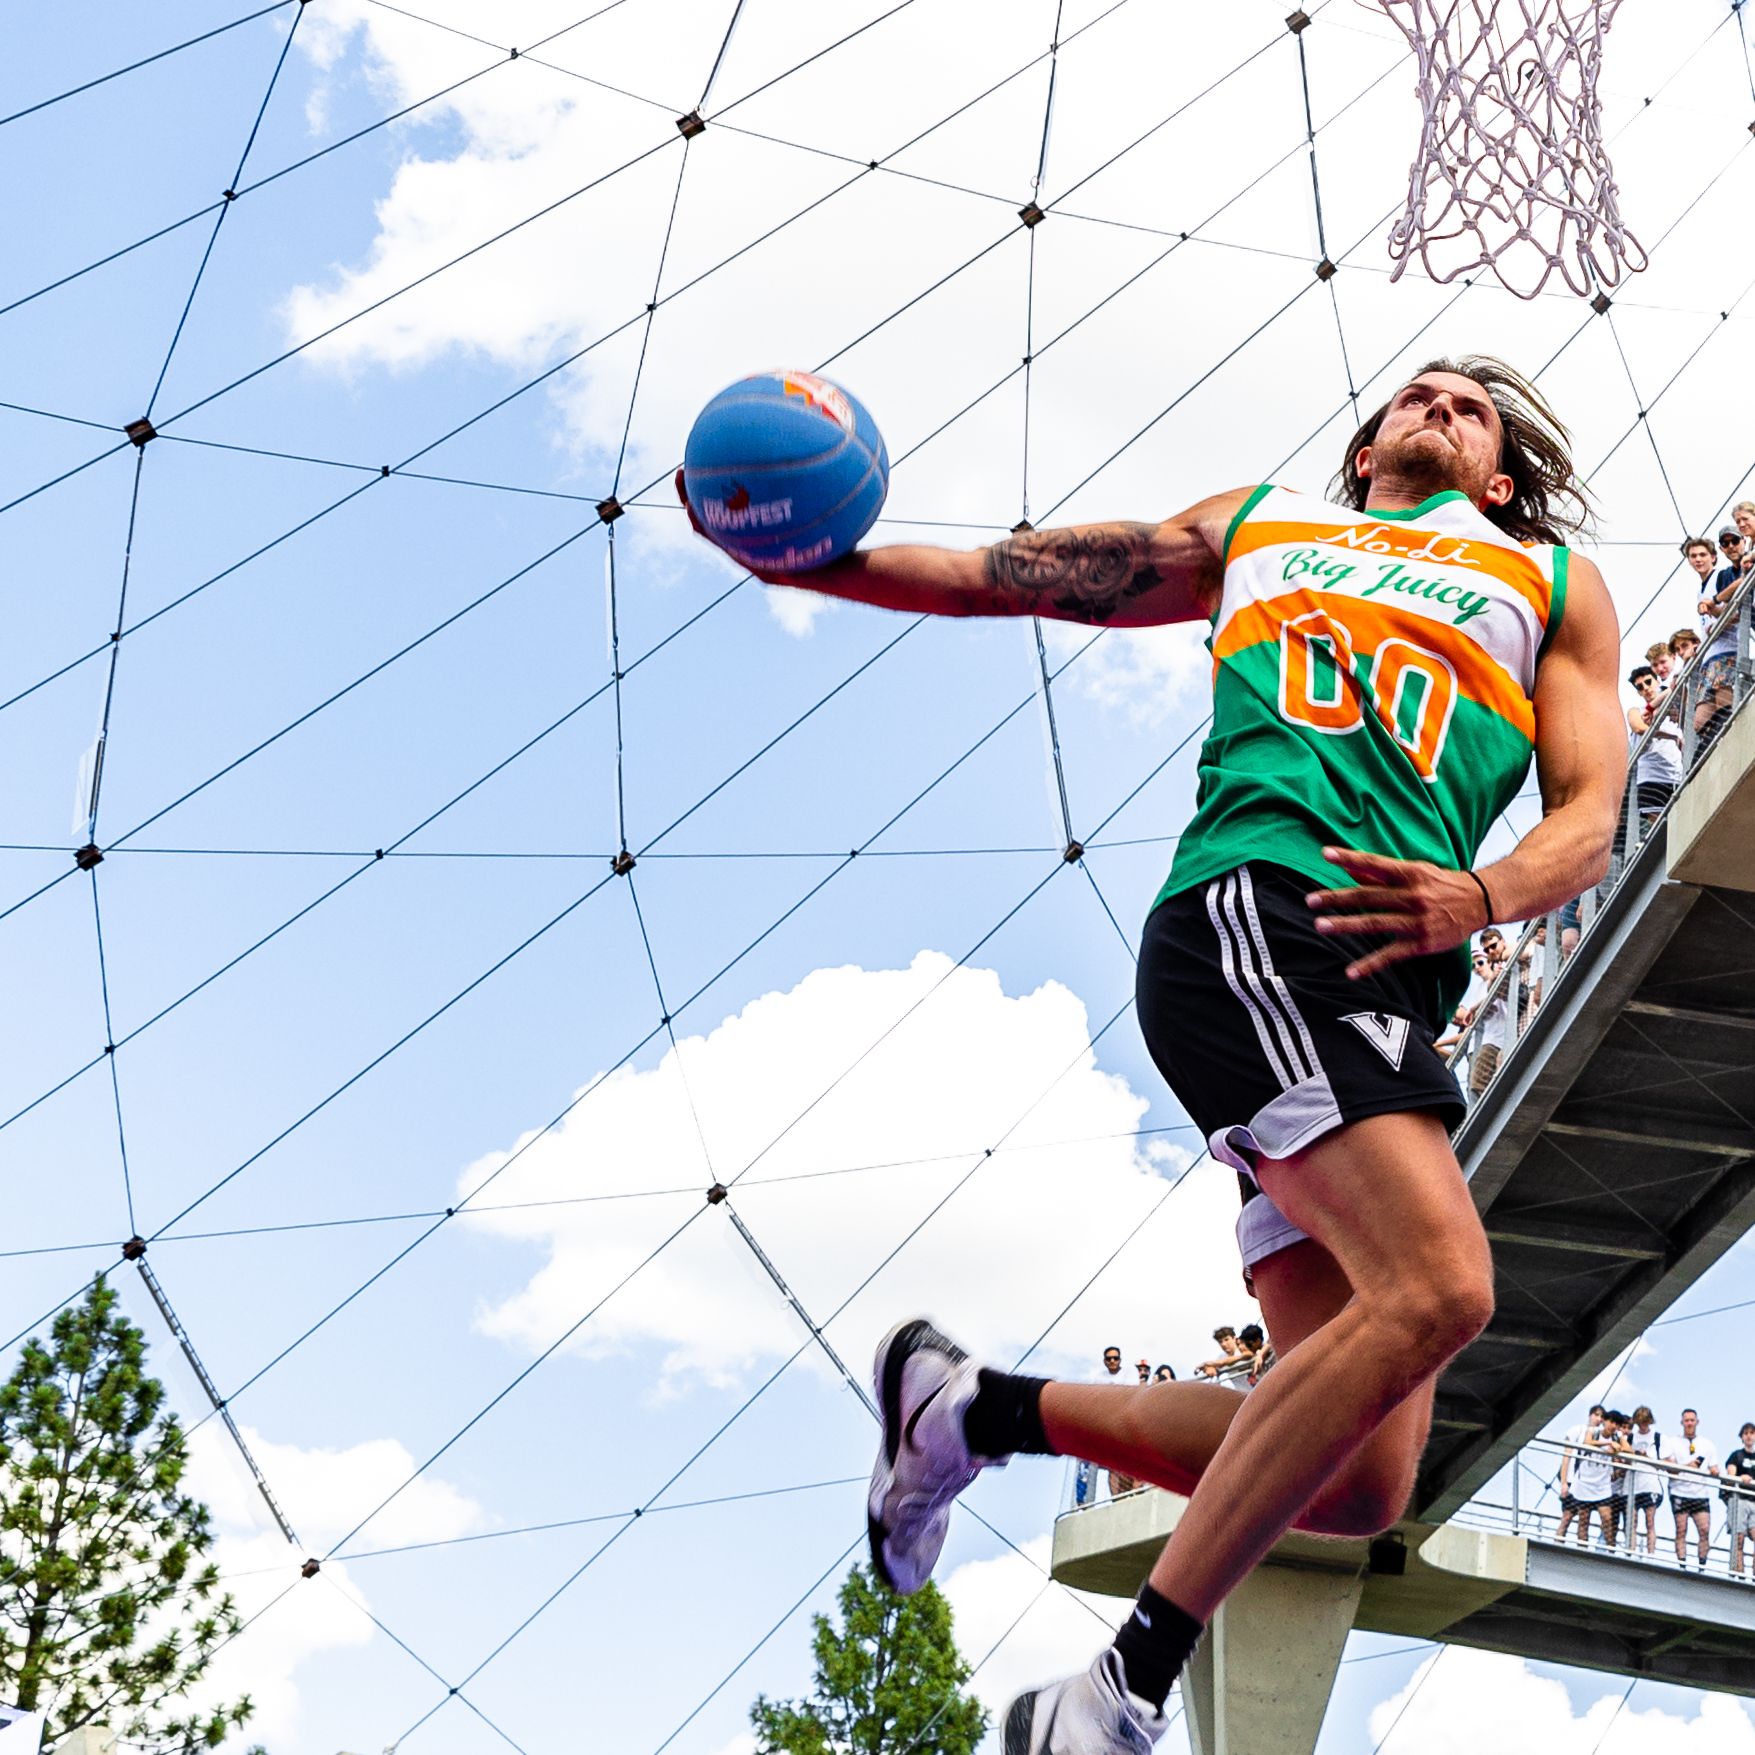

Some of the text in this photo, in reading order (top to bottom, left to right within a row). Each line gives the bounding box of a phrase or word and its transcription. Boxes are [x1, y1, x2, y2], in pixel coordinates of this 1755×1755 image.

[1315, 525, 1481, 565] No-Li
[1282, 548, 1491, 625] Big Juicy
[1278, 608, 1459, 784] 00
